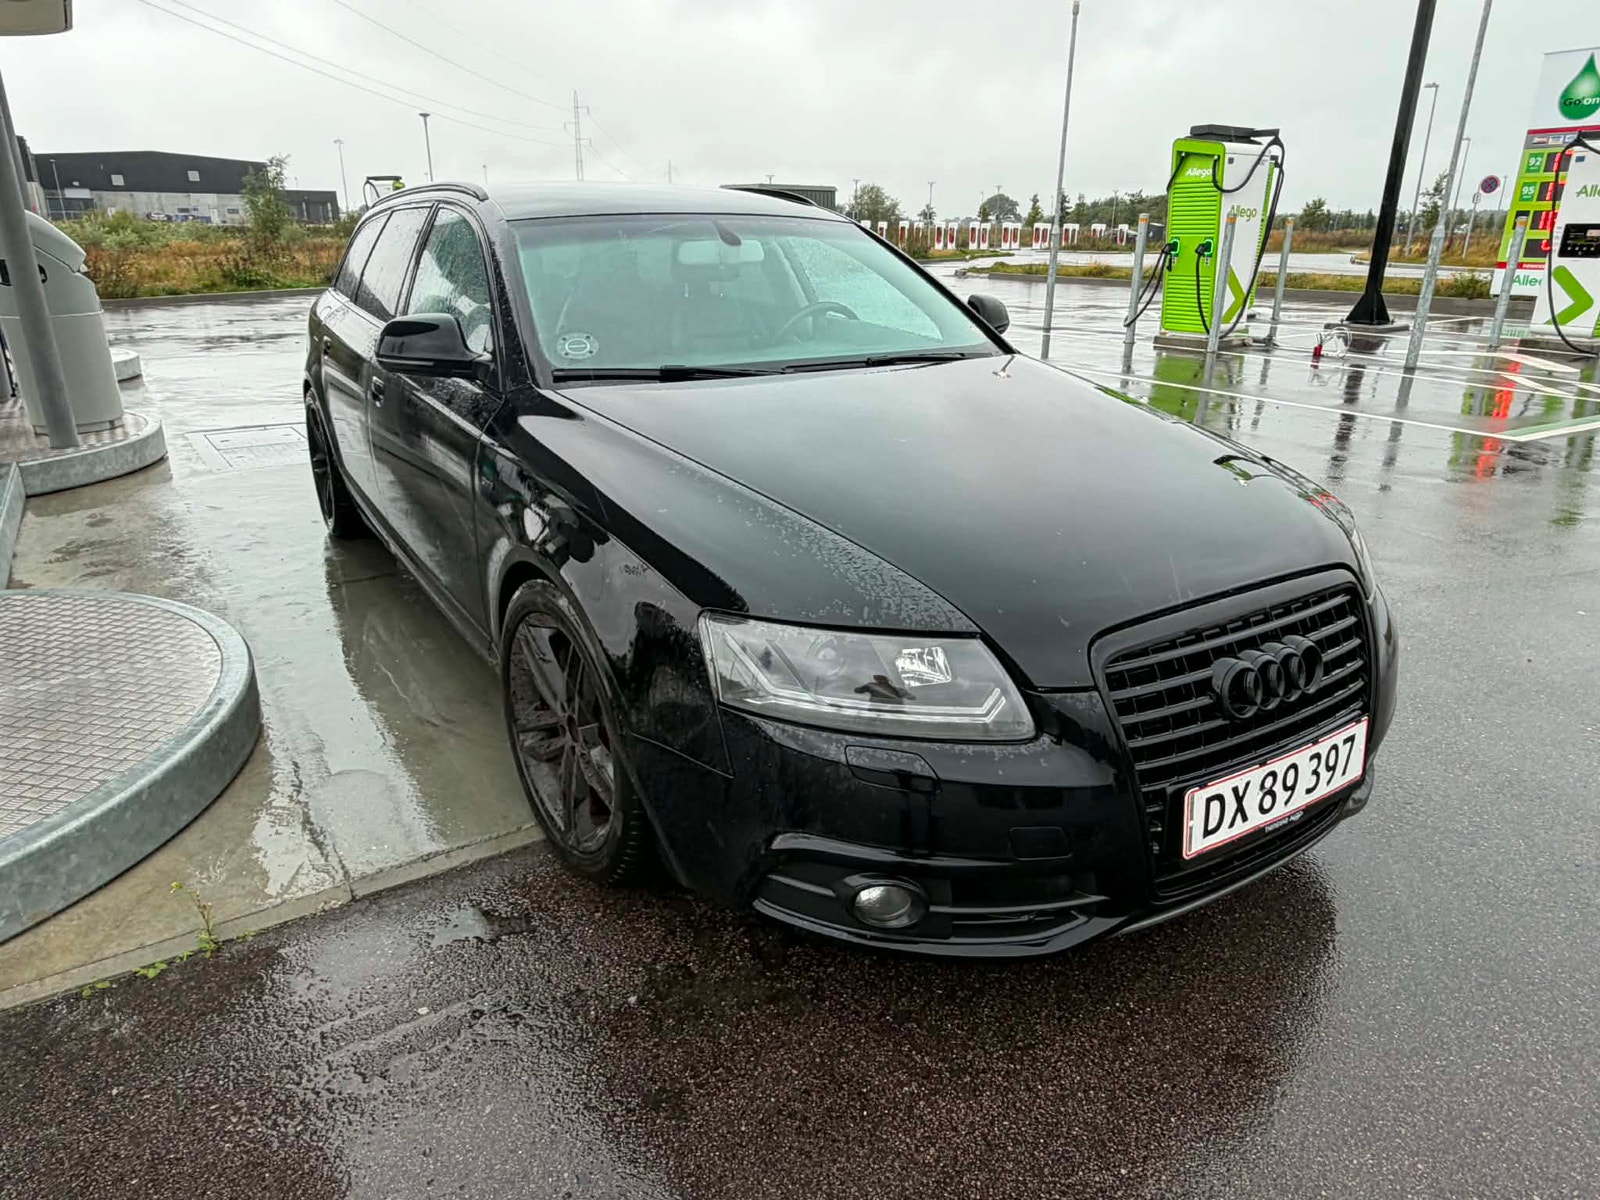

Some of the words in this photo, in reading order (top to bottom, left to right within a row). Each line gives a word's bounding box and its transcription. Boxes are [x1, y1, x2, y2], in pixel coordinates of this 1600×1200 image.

[1529, 157, 1542, 167] 92
[1185, 168, 1213, 179] Allego
[1522, 186, 1535, 195] 95
[1203, 780, 1251, 839] DX
[1258, 762, 1299, 815] 89
[1305, 733, 1356, 795] 397
